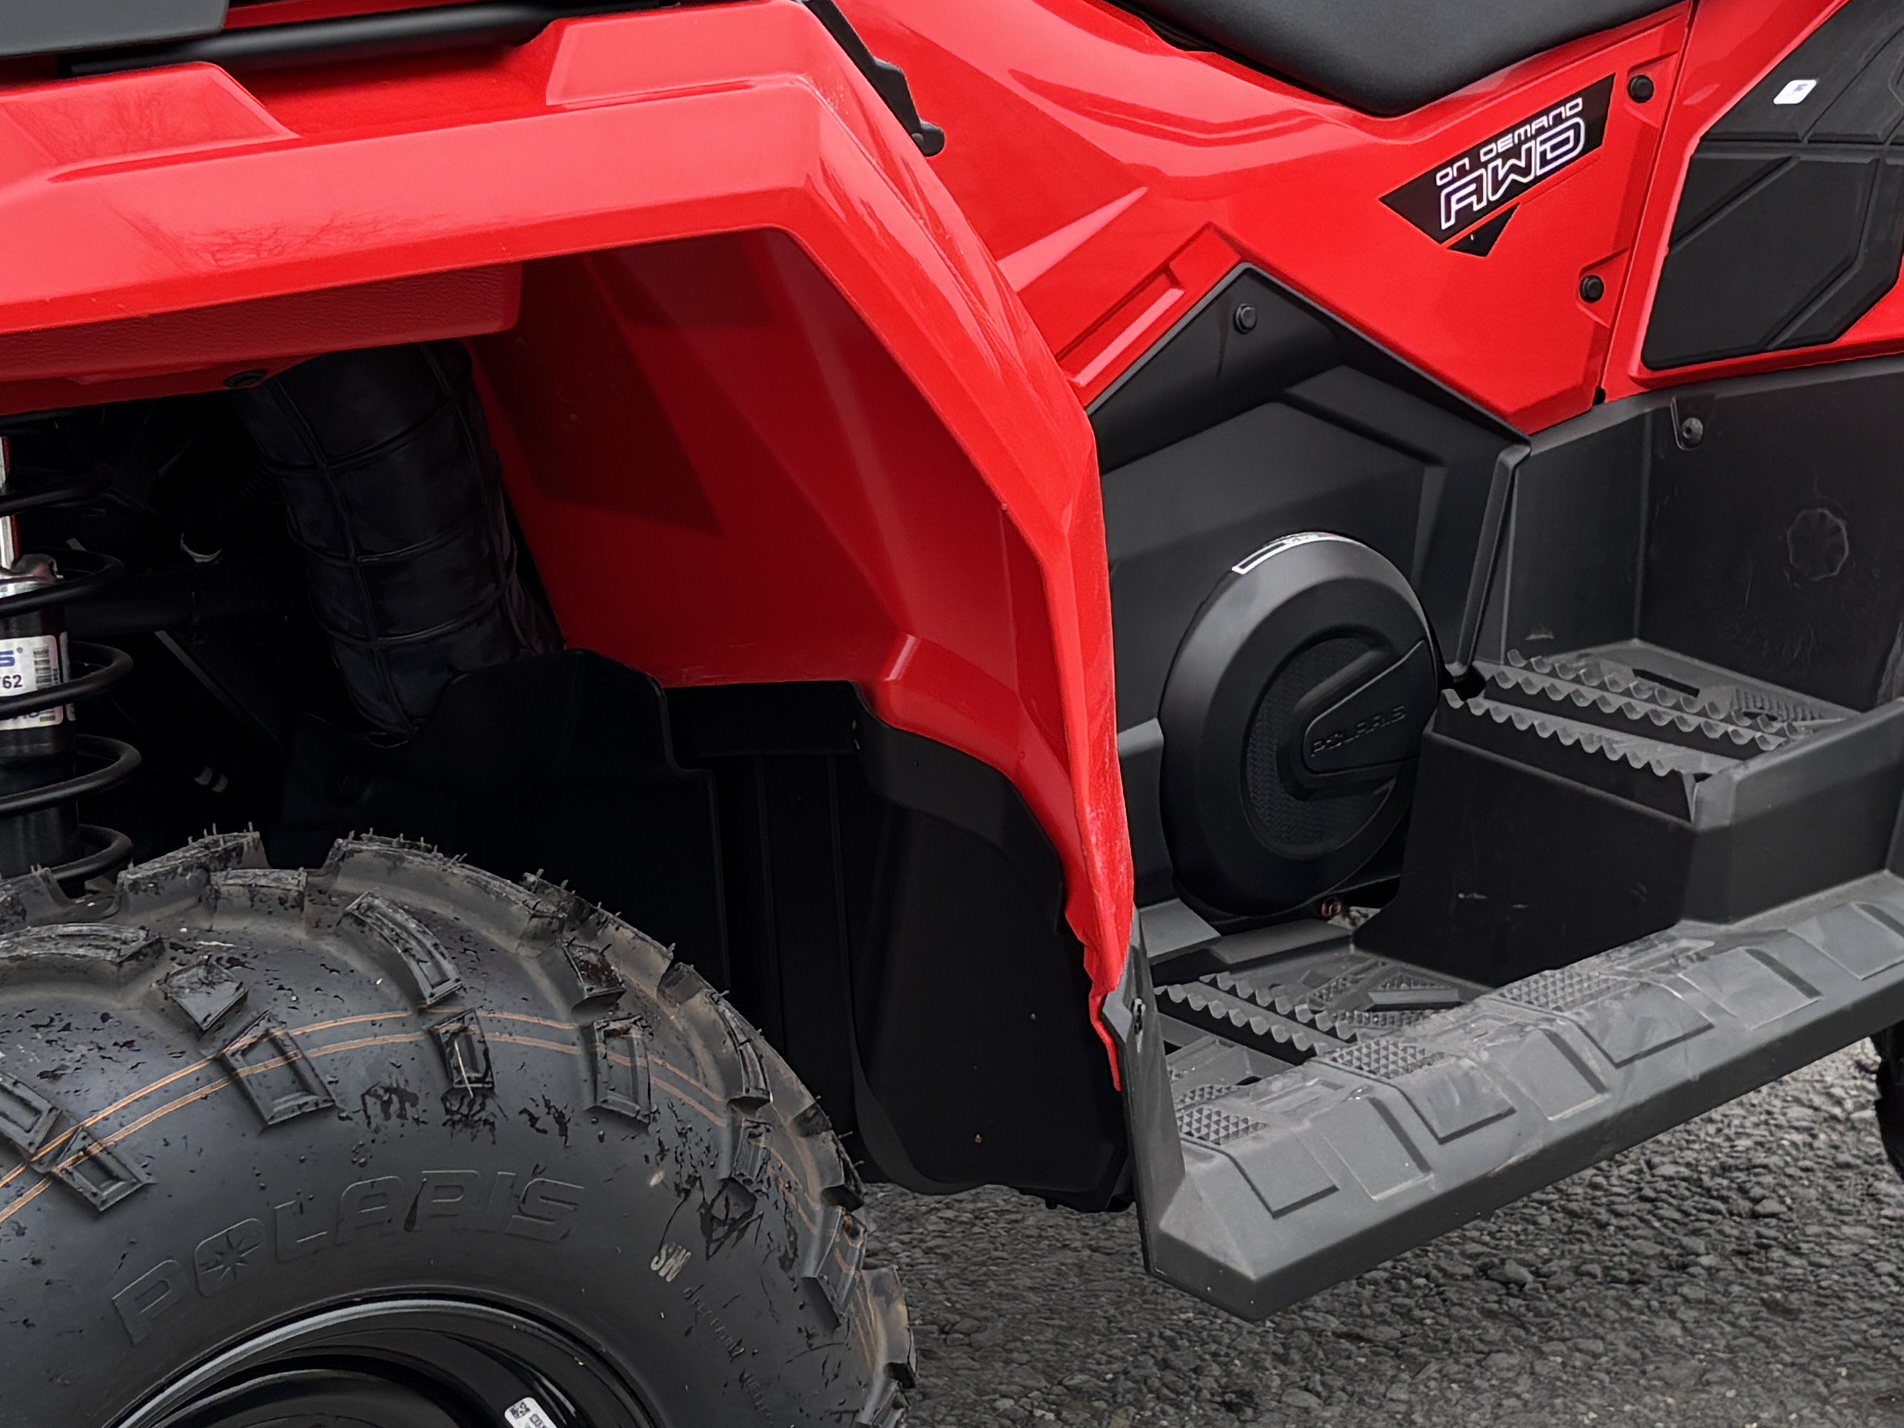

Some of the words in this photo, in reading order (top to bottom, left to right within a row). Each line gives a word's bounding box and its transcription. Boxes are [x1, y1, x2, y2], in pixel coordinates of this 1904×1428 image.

[1435, 158, 1470, 187] ON
[1479, 96, 1584, 163] DEMAND
[1439, 117, 1586, 231] AWD
[1309, 703, 1408, 759] POLARIS
[110, 1169, 587, 1346] POLARIS
